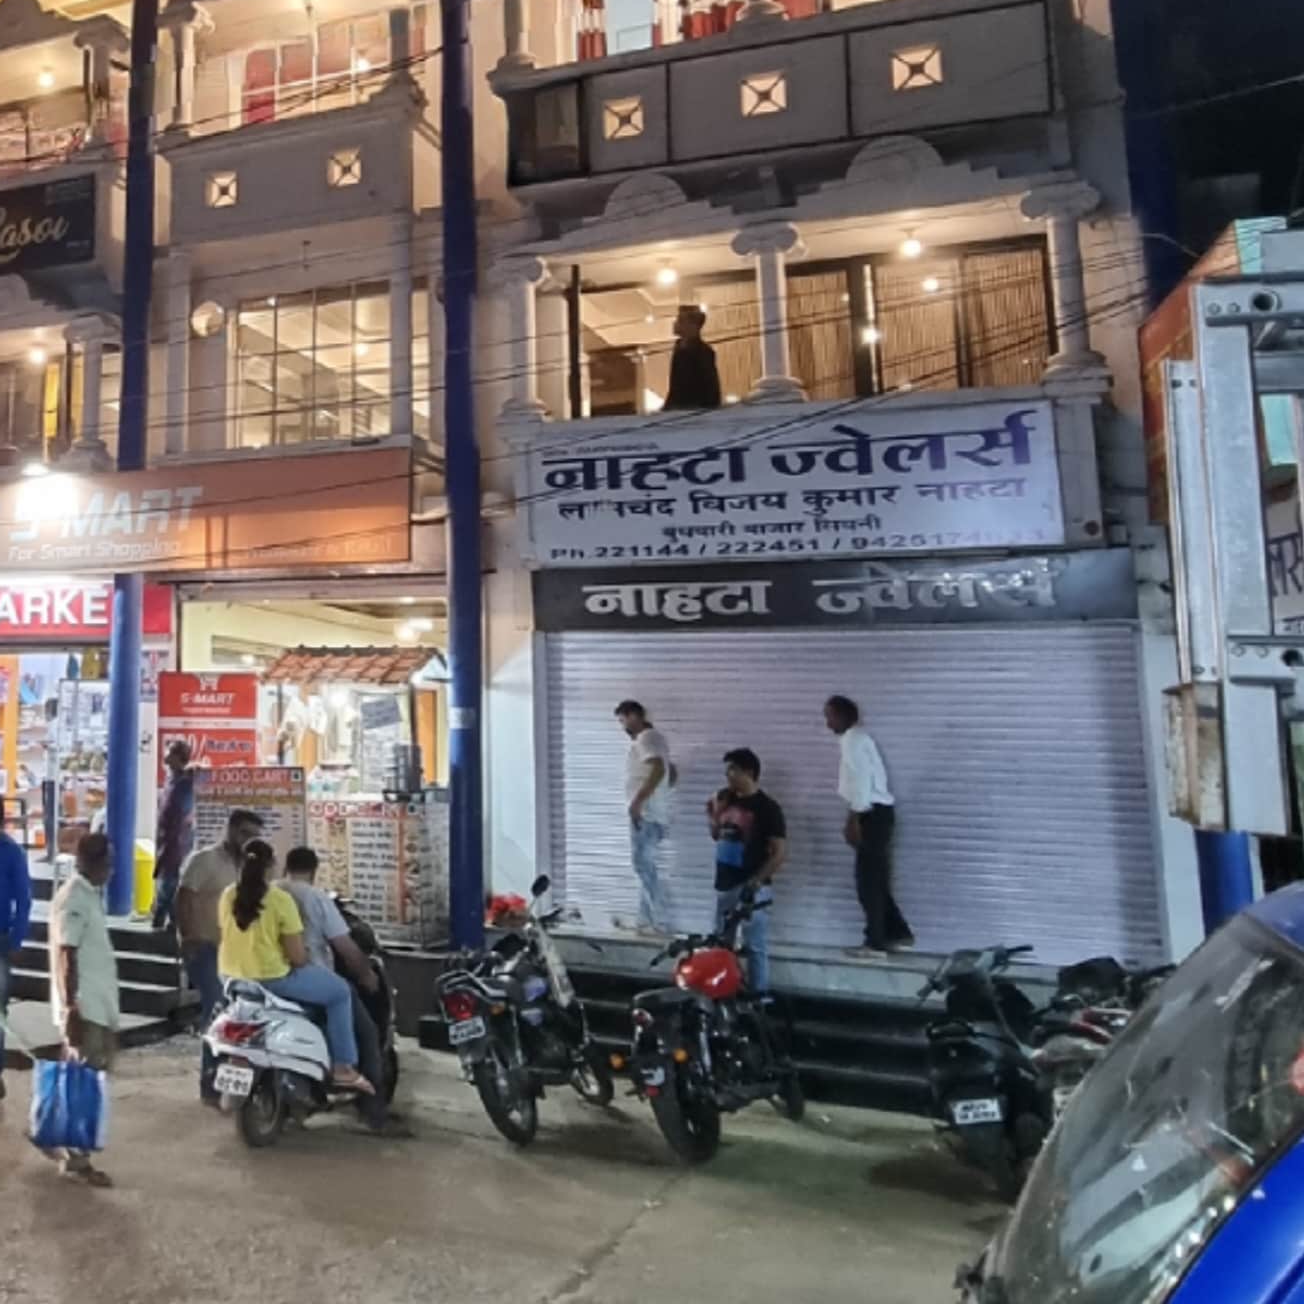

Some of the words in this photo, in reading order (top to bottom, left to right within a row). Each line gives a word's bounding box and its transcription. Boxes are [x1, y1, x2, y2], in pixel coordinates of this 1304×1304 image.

[542, 446, 750, 491] नाहटा
[767, 410, 1038, 476] ज्वेलर्स
[688, 489, 788, 514] विजय
[802, 485, 901, 516] कुमार
[39, 542, 91, 561] Smart
[95, 536, 182, 562] Shopping
[716, 537, 819, 556] 222451
[581, 581, 773, 622] नाहटा
